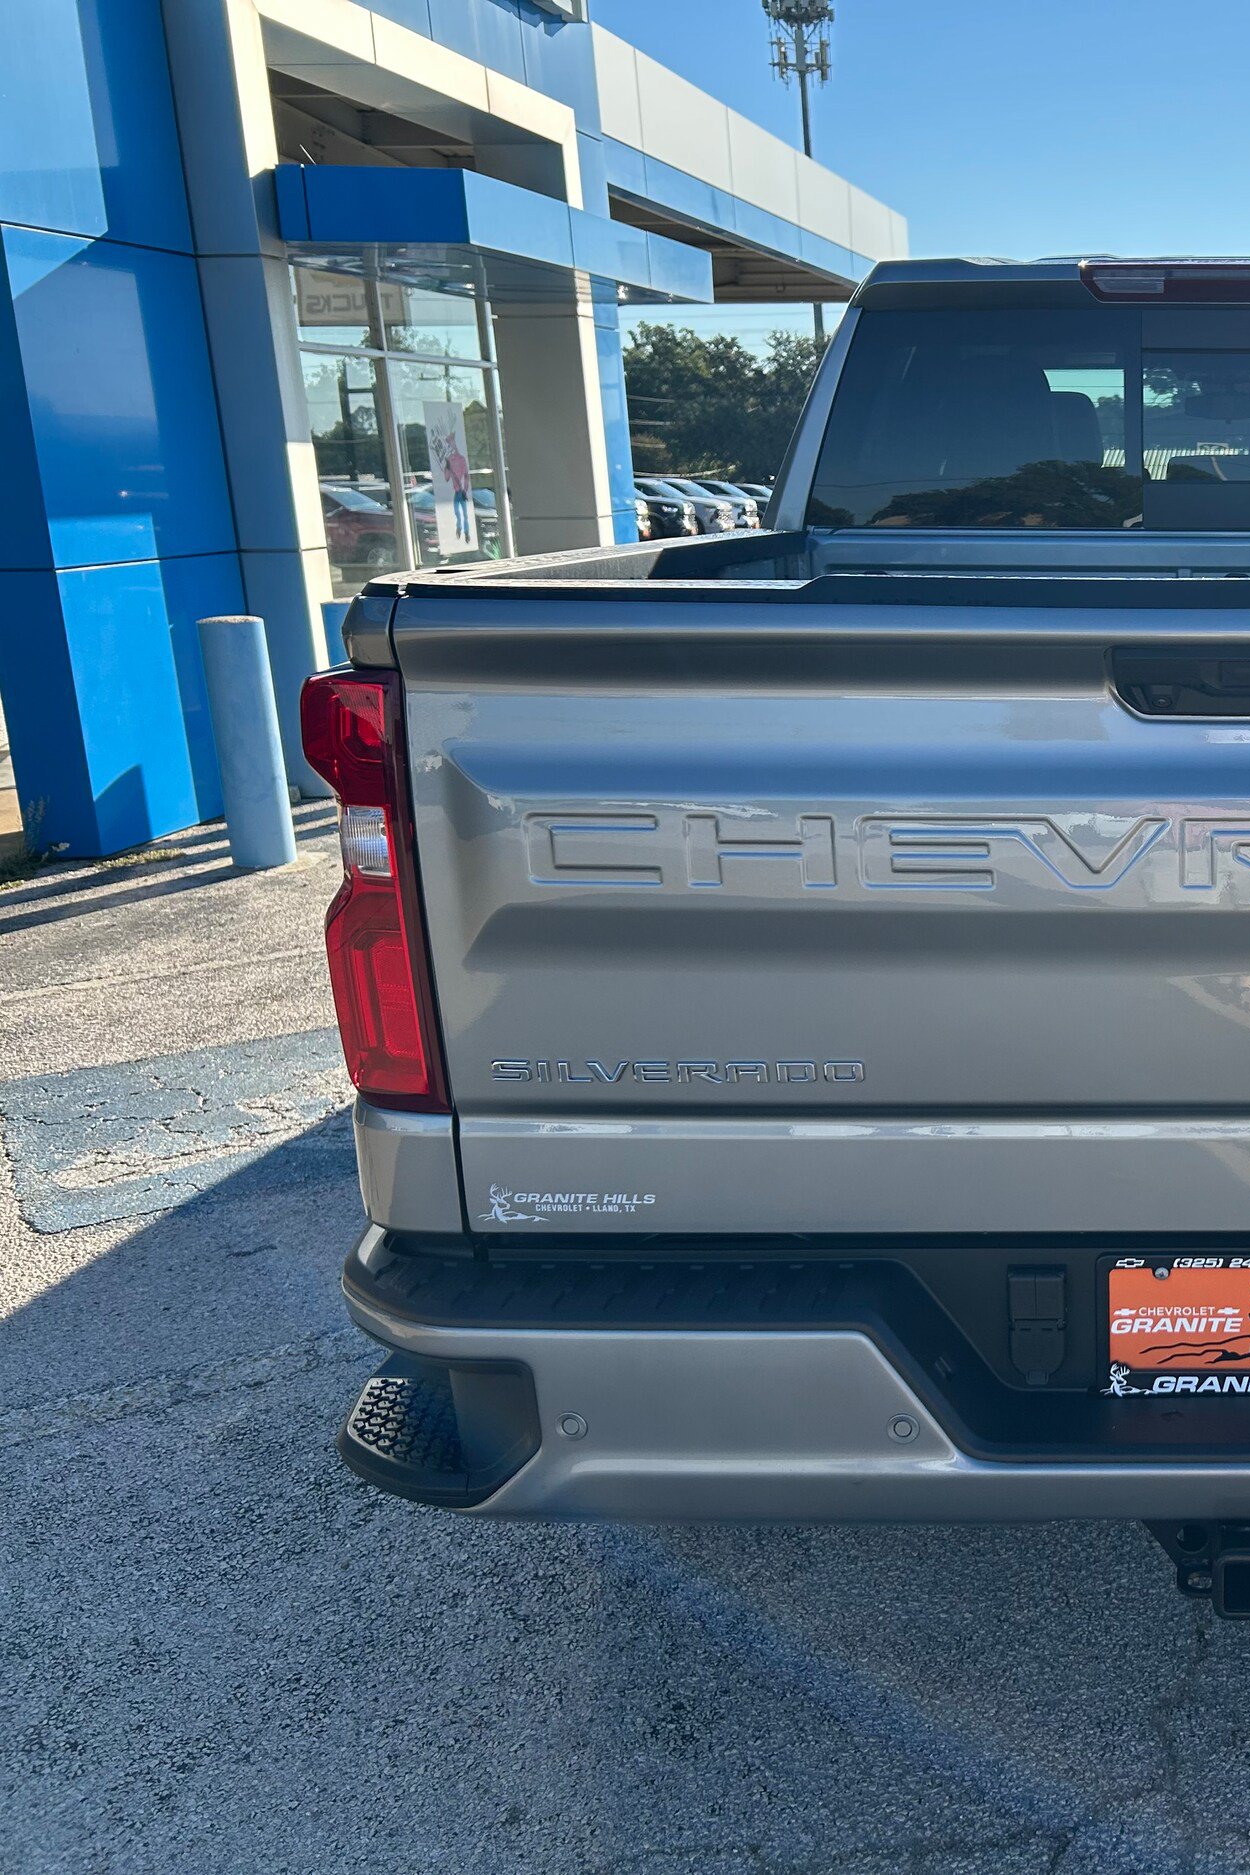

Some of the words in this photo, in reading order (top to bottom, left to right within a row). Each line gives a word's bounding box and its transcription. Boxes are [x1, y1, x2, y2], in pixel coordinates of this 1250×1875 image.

[491, 1059, 867, 1084] SILVERADO
[514, 1192, 599, 1204] GRANITE
[603, 1193, 656, 1205] HILLS
[535, 1204, 583, 1212] CHEVROLET
[625, 1204, 636, 1212] TX
[1173, 1257, 1224, 1269] (325)
[1138, 1306, 1216, 1317] CHEVROLET
[1110, 1317, 1243, 1334] GRANITE
